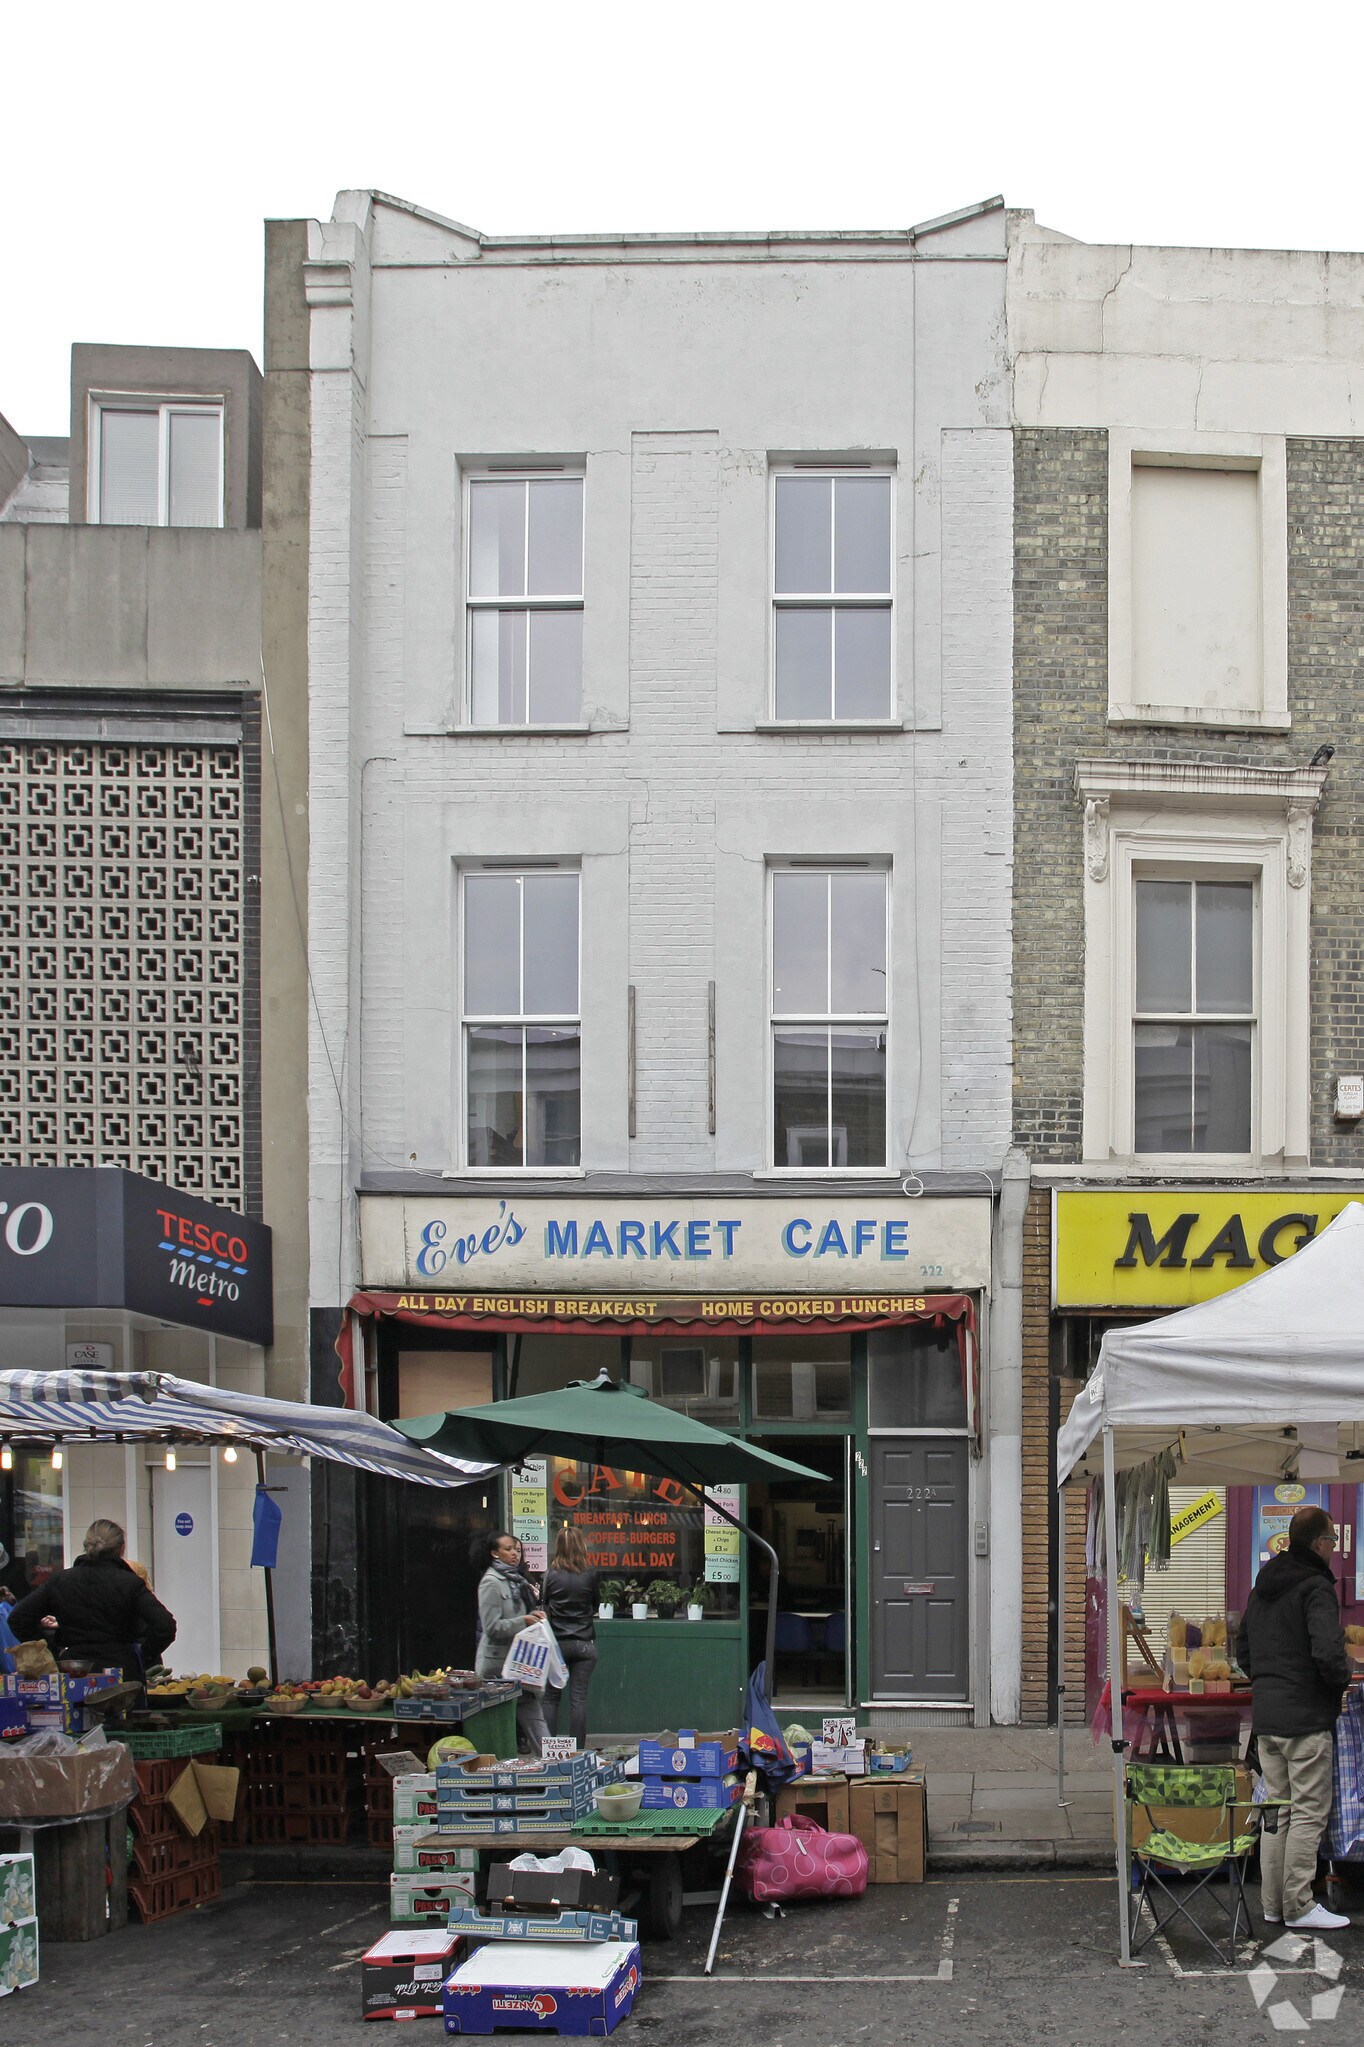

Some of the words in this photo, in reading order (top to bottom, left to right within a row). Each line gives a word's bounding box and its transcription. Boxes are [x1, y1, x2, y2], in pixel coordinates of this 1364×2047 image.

[156, 1209, 248, 1263] TESCO
[416, 1201, 527, 1277] Eve's
[544, 1219, 742, 1260] MARKET
[780, 1218, 910, 1261] CAFE
[1114, 1213, 1342, 1268] MAG
[169, 1258, 240, 1301] Metro
[920, 1265, 943, 1276] 222
[397, 1295, 429, 1310] ALL
[434, 1296, 467, 1311] DAY
[473, 1297, 548, 1314] ENGLISH
[554, 1300, 658, 1316] BREAKFAST
[701, 1301, 754, 1316] HOME
[759, 1300, 835, 1316] COOKED
[841, 1298, 926, 1314] LUNCHES
[74, 1351, 100, 1359] CASE
[634, 1511, 668, 1525] LUNCH
[1169, 1498, 1216, 1536] ANAGEMENT
[586, 1551, 618, 1567] RVED
[621, 1551, 646, 1567] ALL
[649, 1551, 676, 1567] DAY
[418, 1802, 437, 1815] PAS
[493, 2000, 543, 2011] VANZETTI
